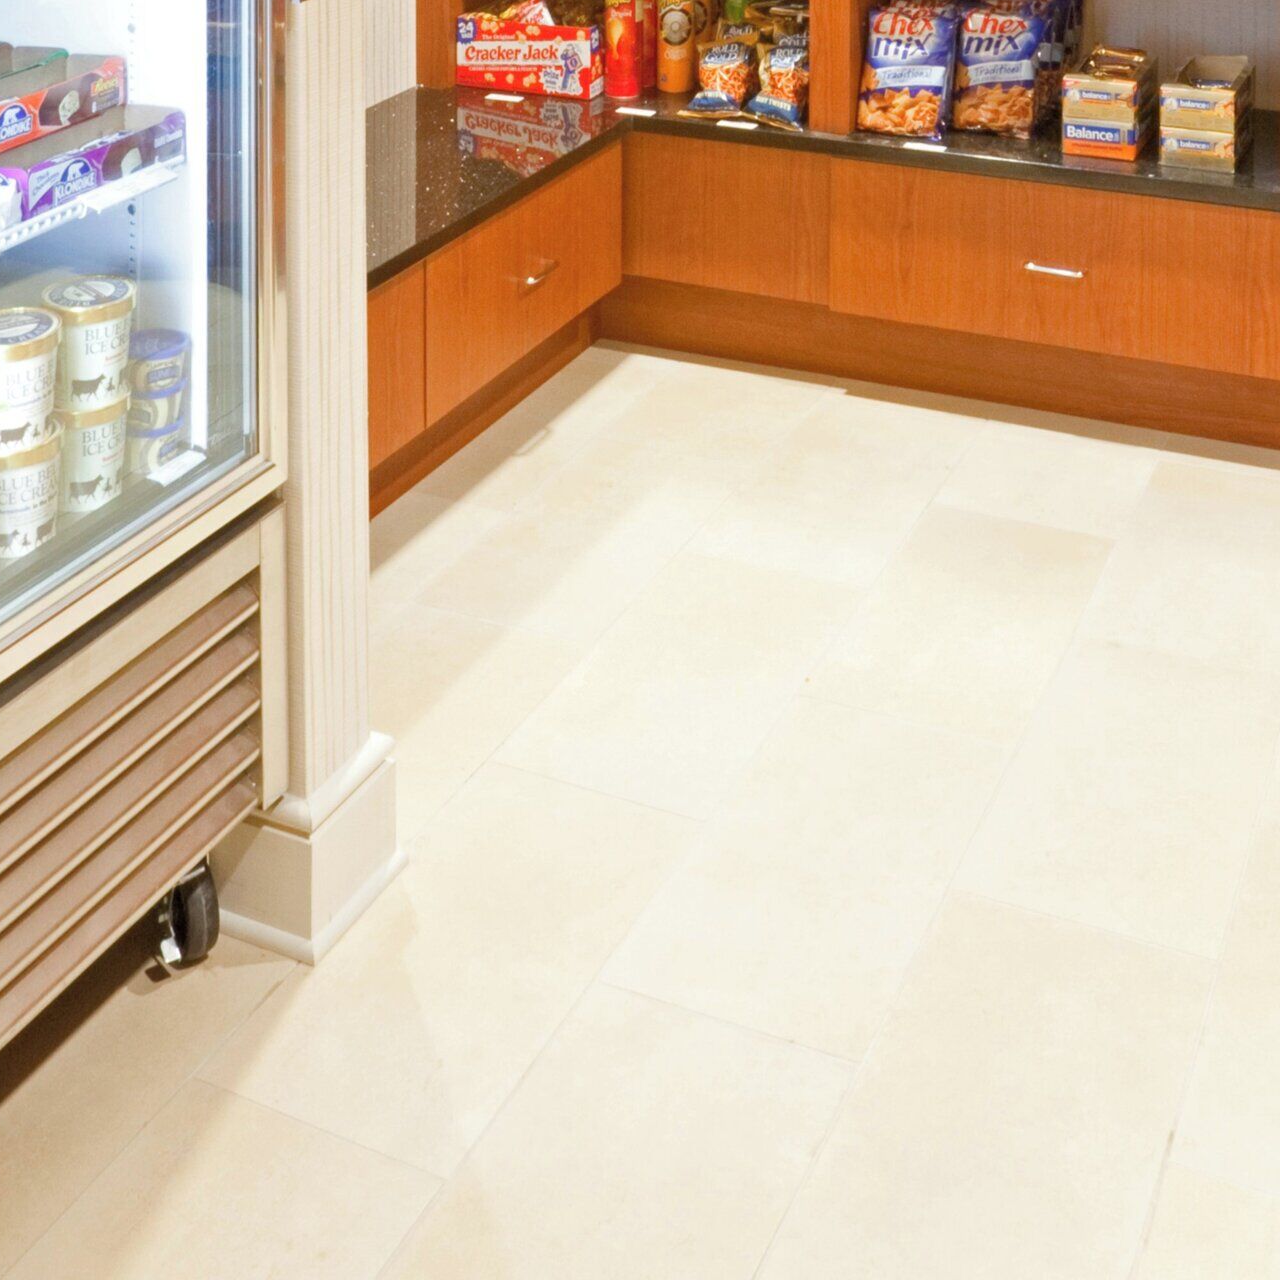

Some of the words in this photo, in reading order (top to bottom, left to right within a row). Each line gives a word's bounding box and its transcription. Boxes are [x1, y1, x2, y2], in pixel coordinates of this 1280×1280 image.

[873, 10, 934, 36] Chex
[963, 8, 1027, 34] Chex
[873, 33, 933, 60] mix
[964, 31, 1024, 56] mix
[465, 45, 521, 62] Cracker
[523, 45, 558, 60] Jack
[882, 68, 932, 80] Traditional
[974, 64, 1023, 77] Traditional
[1180, 100, 1206, 109] balance
[1066, 125, 1114, 141] Balance
[1180, 140, 1206, 149] balance
[54, 173, 95, 202] KLONDIKE
[20, 480, 57, 502] CREA
